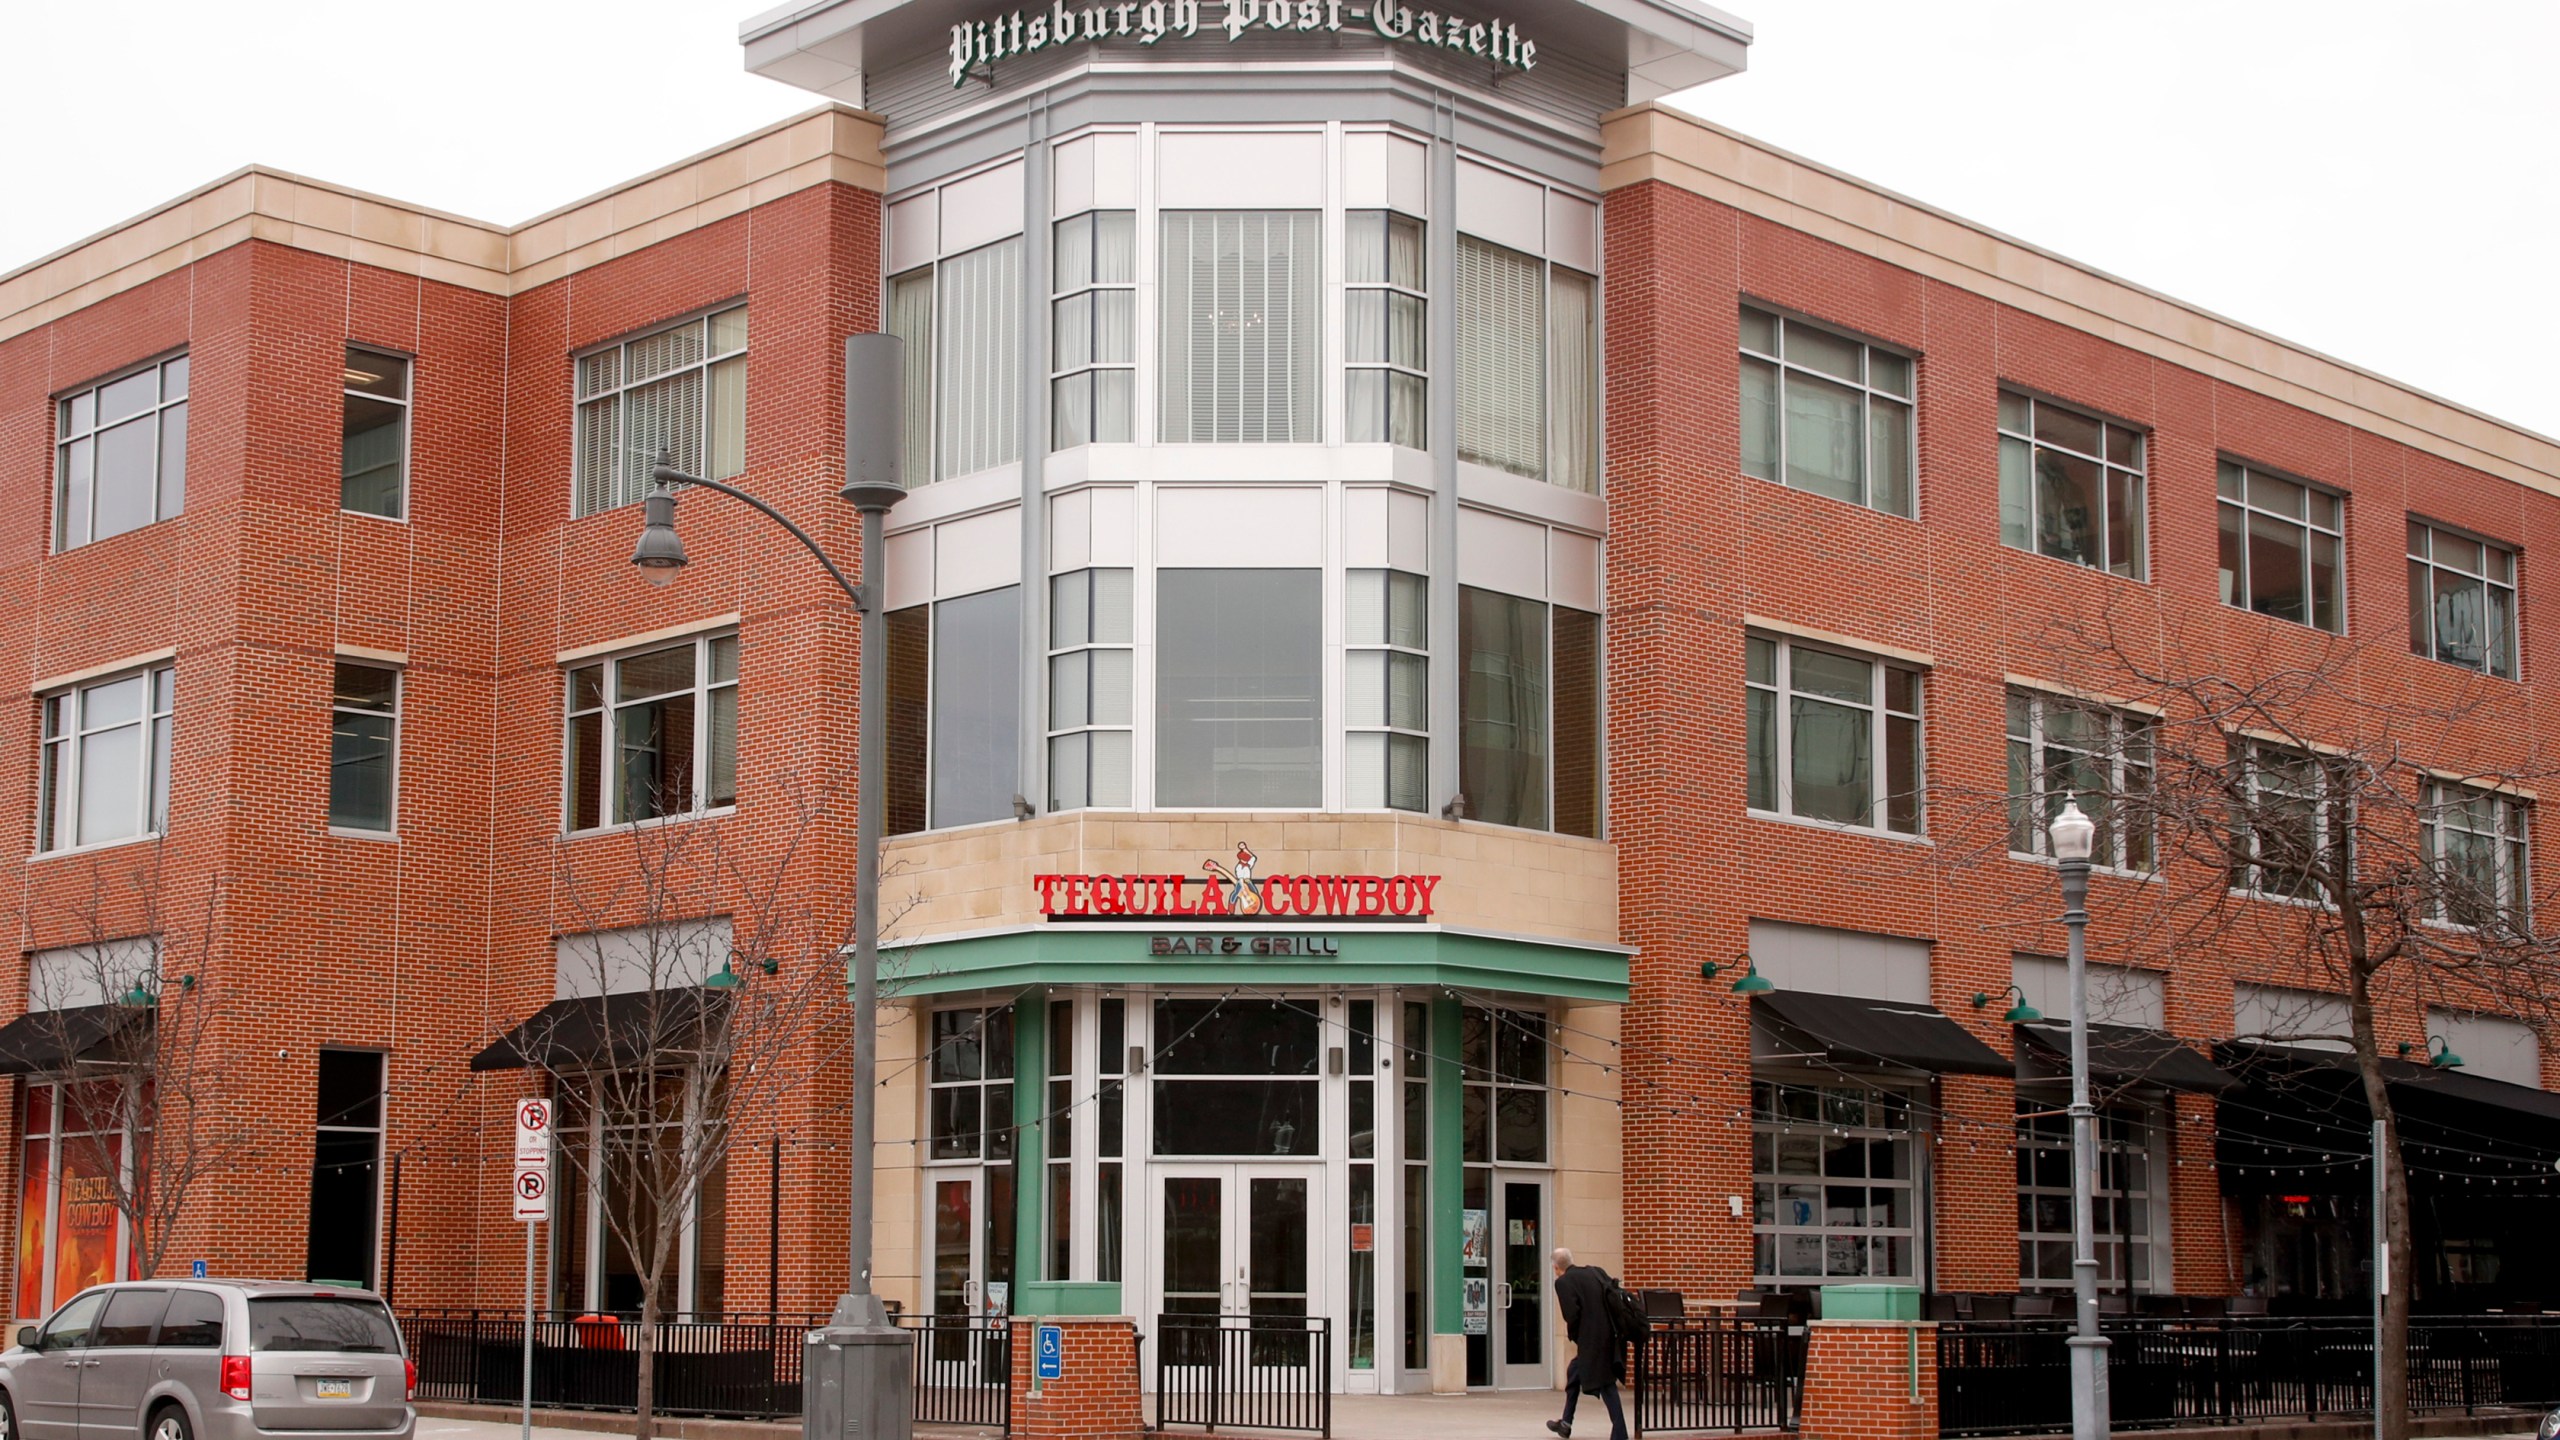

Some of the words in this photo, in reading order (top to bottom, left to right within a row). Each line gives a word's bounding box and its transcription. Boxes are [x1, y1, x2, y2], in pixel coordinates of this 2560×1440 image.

[949, 0, 1200, 88] Pittsburgh
[1222, 0, 1540, 71] Post-Gazette
[1034, 874, 1229, 915] TEQUILA
[1261, 874, 1441, 916] COWBOY
[1151, 936, 1212, 955] BAR
[1220, 937, 1242, 954] &
[1250, 936, 1338, 956] GRILL
[528, 1135, 537, 1143] OR
[519, 1147, 546, 1155] STOPPING
[66, 1202, 114, 1227] COWBOY
